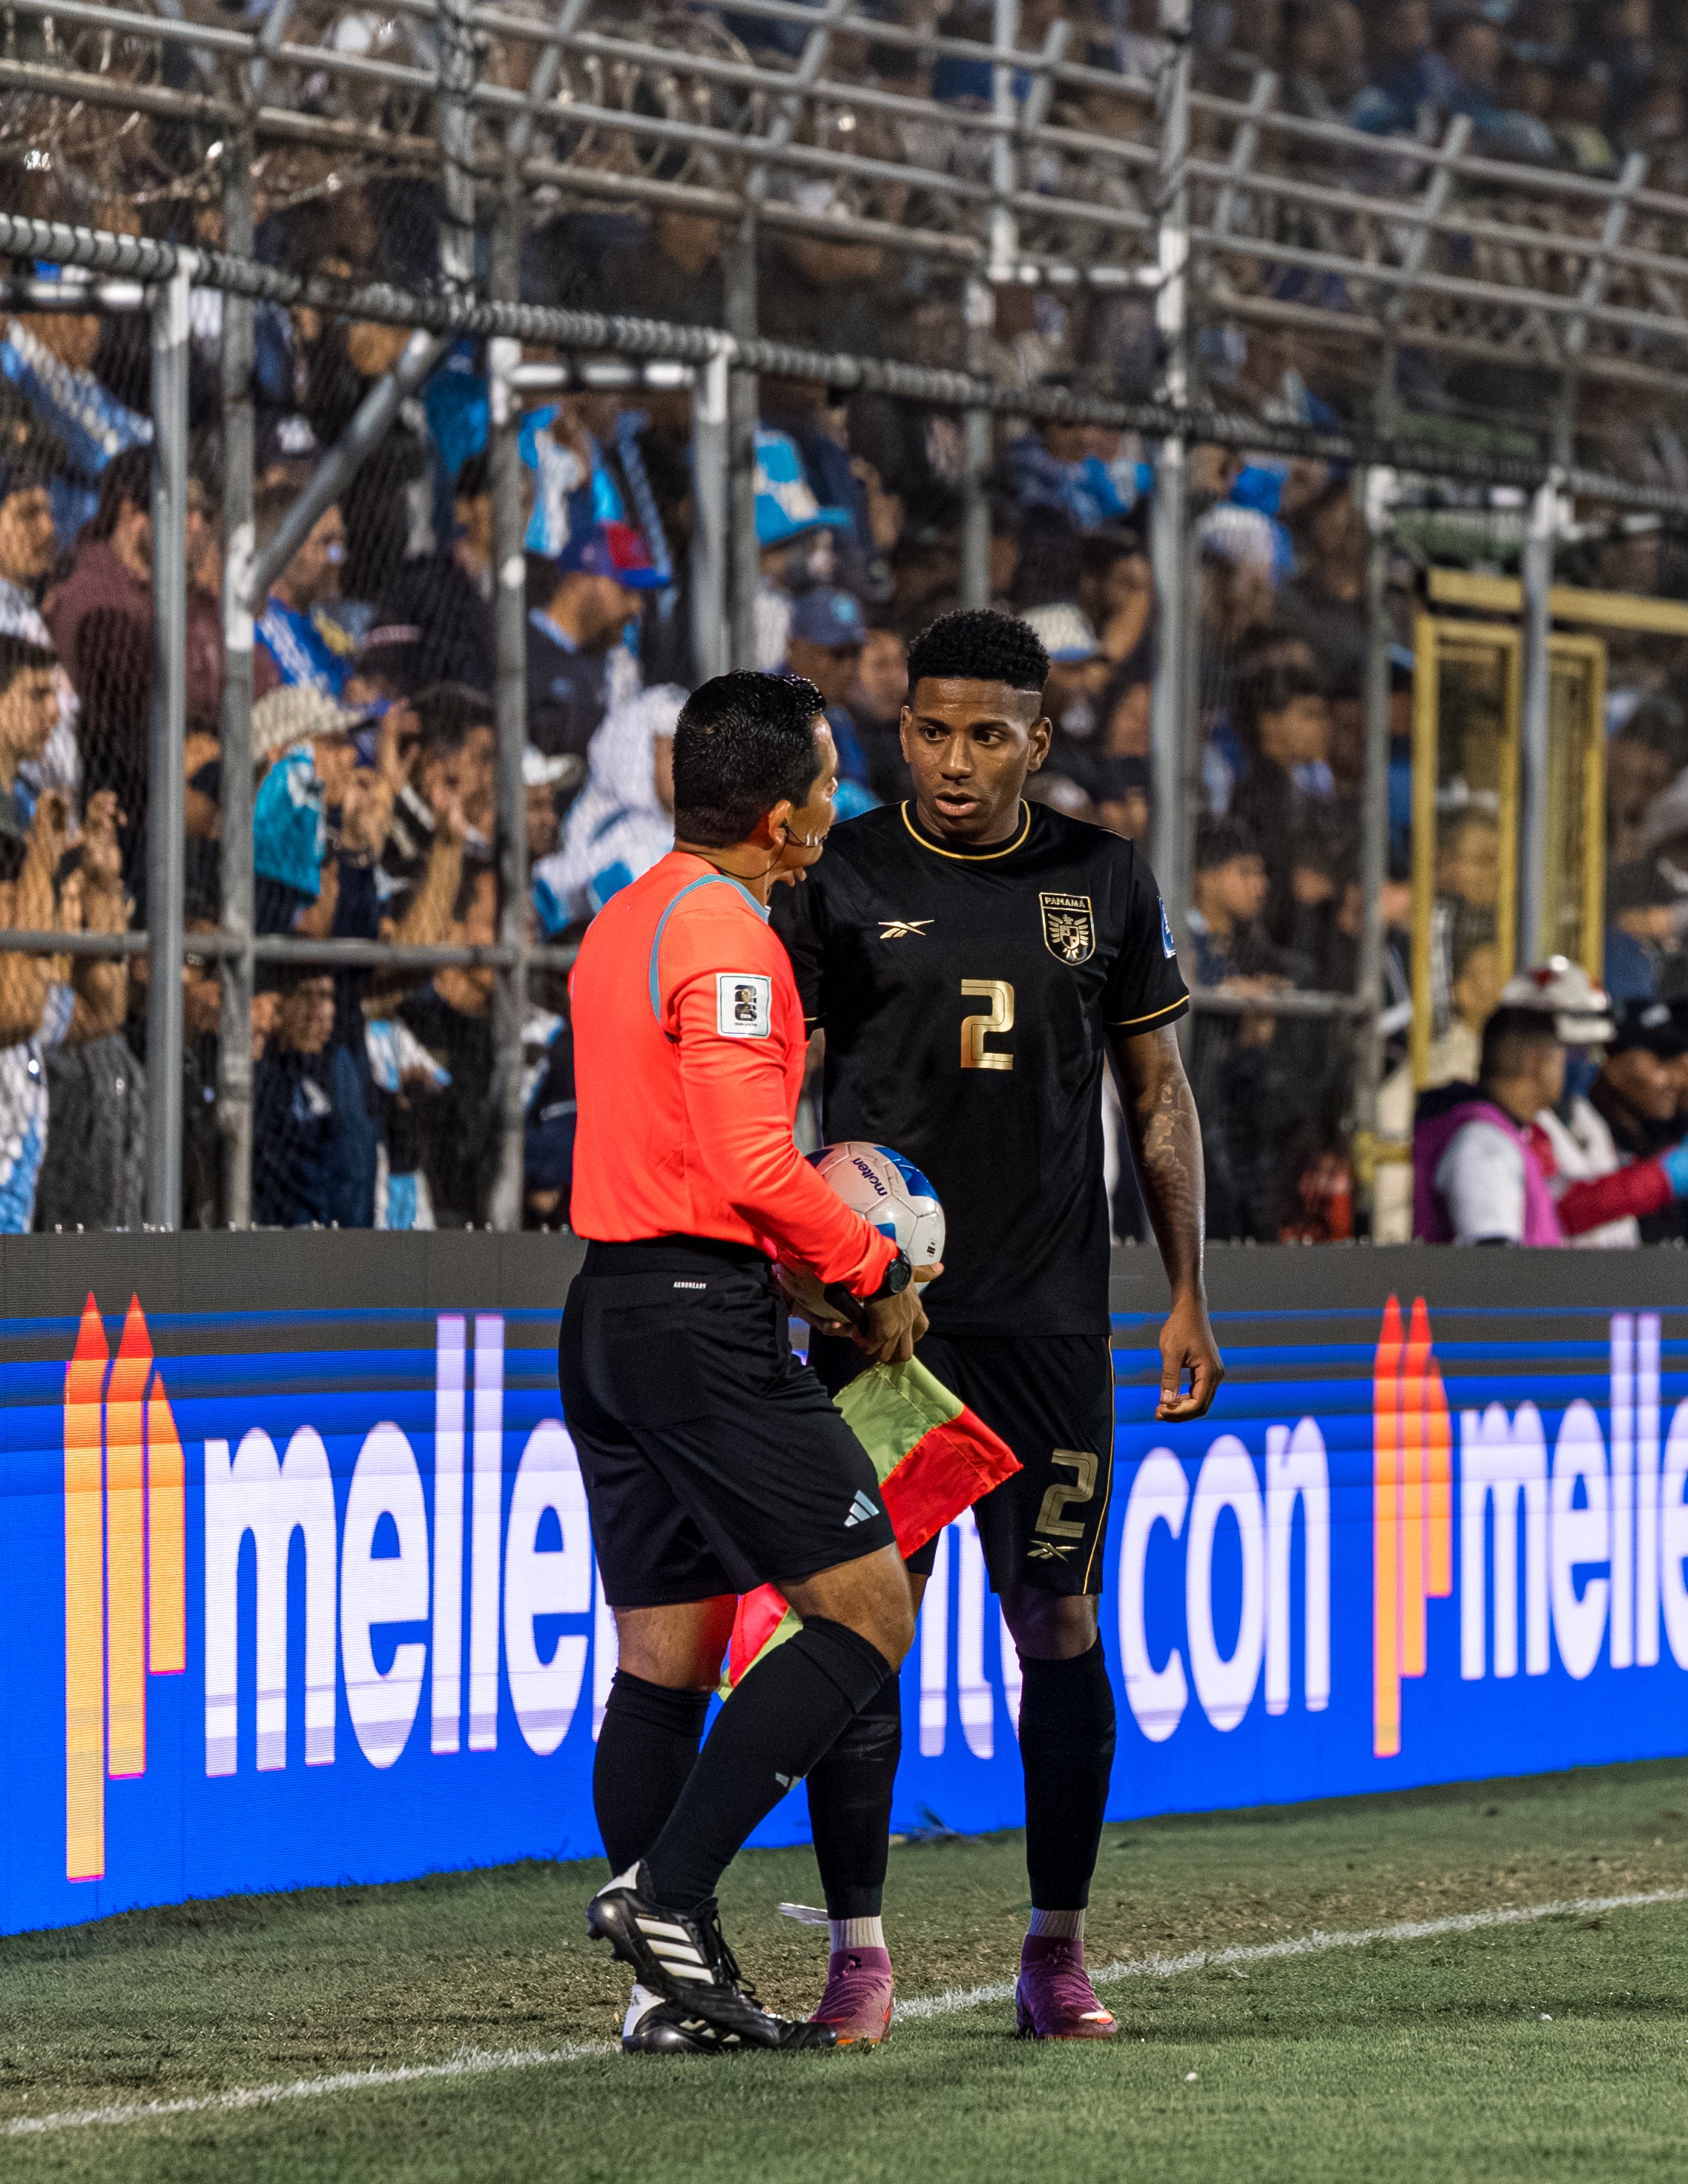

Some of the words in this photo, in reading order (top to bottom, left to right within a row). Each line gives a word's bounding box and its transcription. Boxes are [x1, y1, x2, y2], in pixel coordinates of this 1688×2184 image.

[960, 978, 1015, 1070] 2
[851, 1157, 888, 1196] molten
[673, 1281, 708, 1290] AEROREADY
[1035, 1448, 1098, 1539] 2
